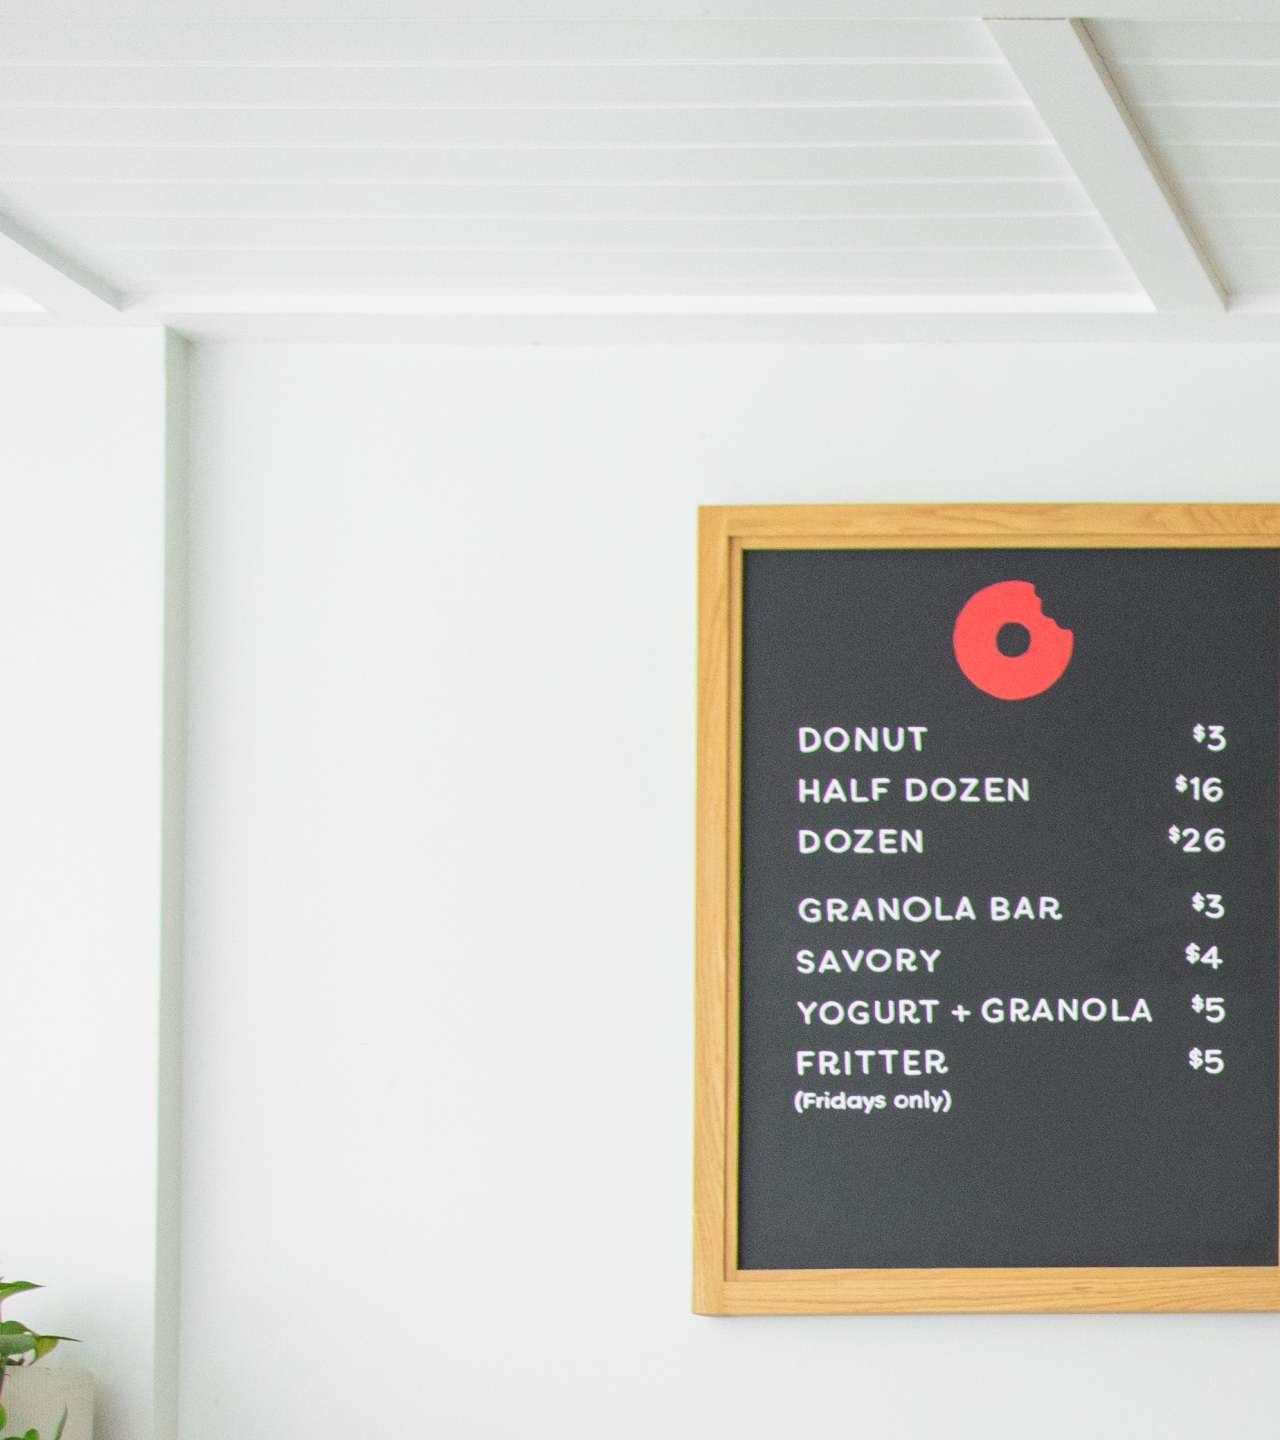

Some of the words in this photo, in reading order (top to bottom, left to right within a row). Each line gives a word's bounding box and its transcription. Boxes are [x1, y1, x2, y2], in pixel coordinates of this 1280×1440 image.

[798, 725, 929, 754] DONUT
[1192, 722, 1227, 753] $3
[798, 777, 891, 805] HALF
[904, 776, 1030, 803] DOZEN
[1174, 773, 1224, 803] $16
[797, 827, 924, 855] DOZEN
[1168, 823, 1227, 853] $26
[797, 895, 977, 924] GRANOLA
[989, 895, 1064, 922] BAR
[1191, 891, 1225, 920] $3
[795, 947, 942, 975] SAVORY
[1184, 941, 1224, 970] $4
[796, 998, 941, 1026] YOGURT
[950, 1003, 972, 1023] +
[980, 996, 1153, 1025] GRANOLA
[1191, 993, 1226, 1024] $5
[795, 1048, 950, 1077] FRITTER
[1188, 1046, 1225, 1075] $5
[794, 1089, 886, 1115] (Fridays
[893, 1088, 953, 1114] only)
